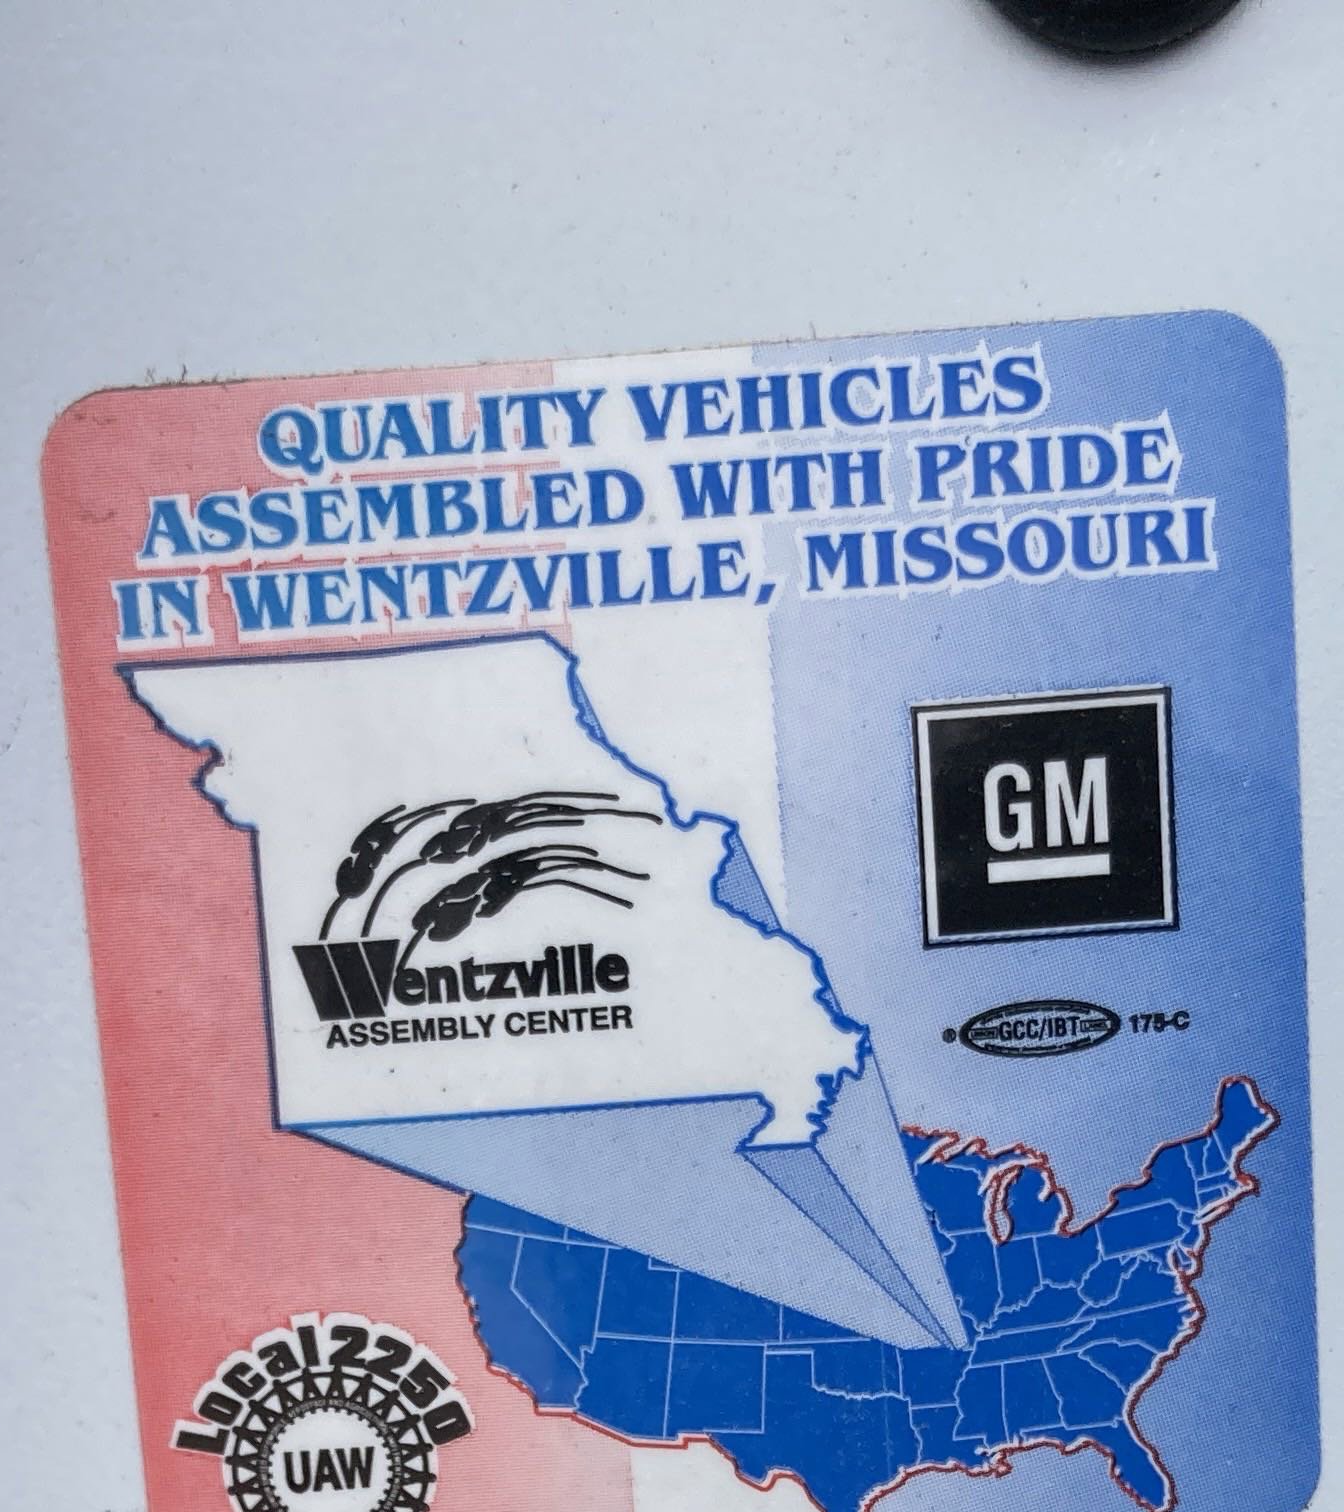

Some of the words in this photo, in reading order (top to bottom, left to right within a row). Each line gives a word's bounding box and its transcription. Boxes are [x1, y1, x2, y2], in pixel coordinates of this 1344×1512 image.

[260, 386, 606, 475] QUALITY
[627, 354, 1044, 441] VEHICLES
[139, 468, 645, 559] ASSEMBLED
[669, 448, 884, 520] WITH
[914, 426, 1174, 503] PRIDE
[116, 578, 200, 641] IN
[224, 541, 775, 634] WENTZVILLE,
[804, 506, 1211, 594] MISSOURI
[983, 756, 1110, 853] GM
[292, 938, 630, 1022] Wentzville
[326, 1011, 497, 1050] ASSEMBLY
[504, 1004, 634, 1037] CENTER
[998, 1016, 1081, 1042] GCC/IBT
[283, 1446, 376, 1494] UAW
